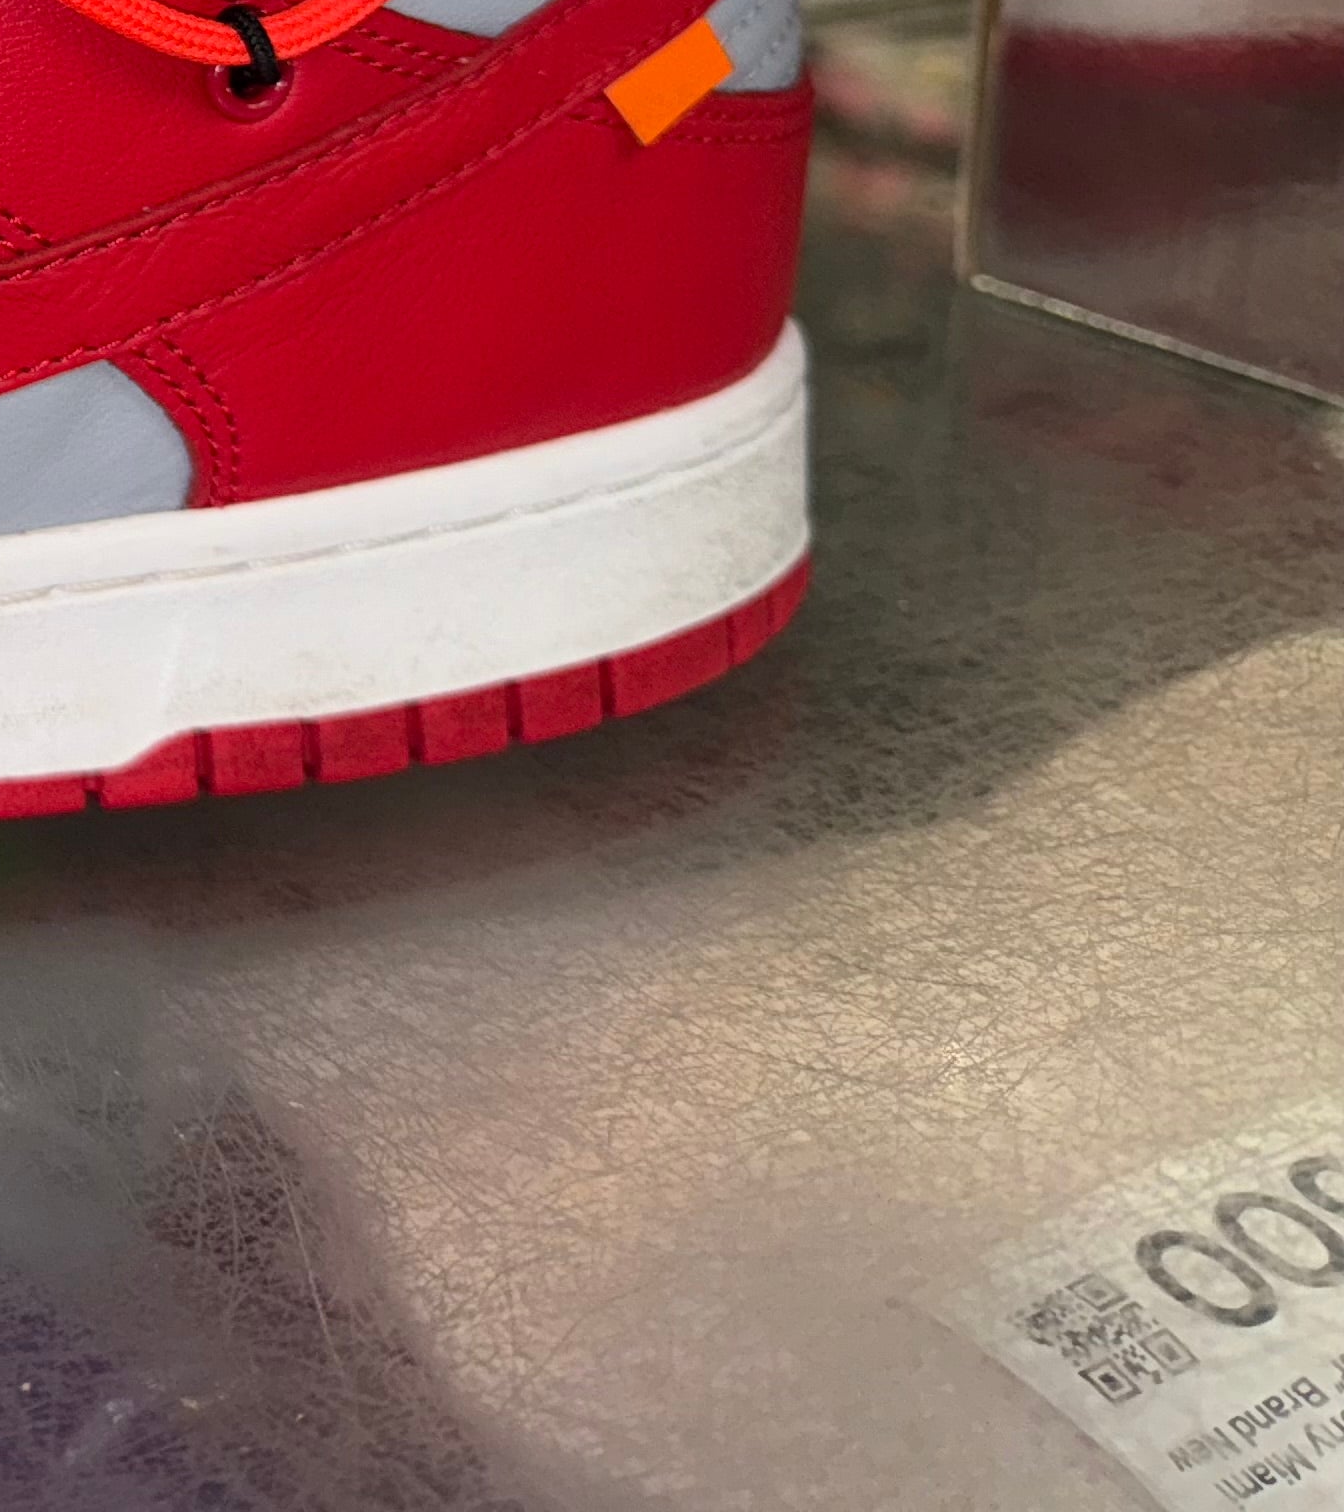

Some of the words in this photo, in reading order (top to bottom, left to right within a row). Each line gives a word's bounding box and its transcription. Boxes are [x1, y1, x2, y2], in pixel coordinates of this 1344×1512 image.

[1227, 1376, 1330, 1448] Brand
[1303, 1409, 1344, 1457] ny
[1168, 1426, 1242, 1472] New
[1214, 1443, 1317, 1511] Miami
